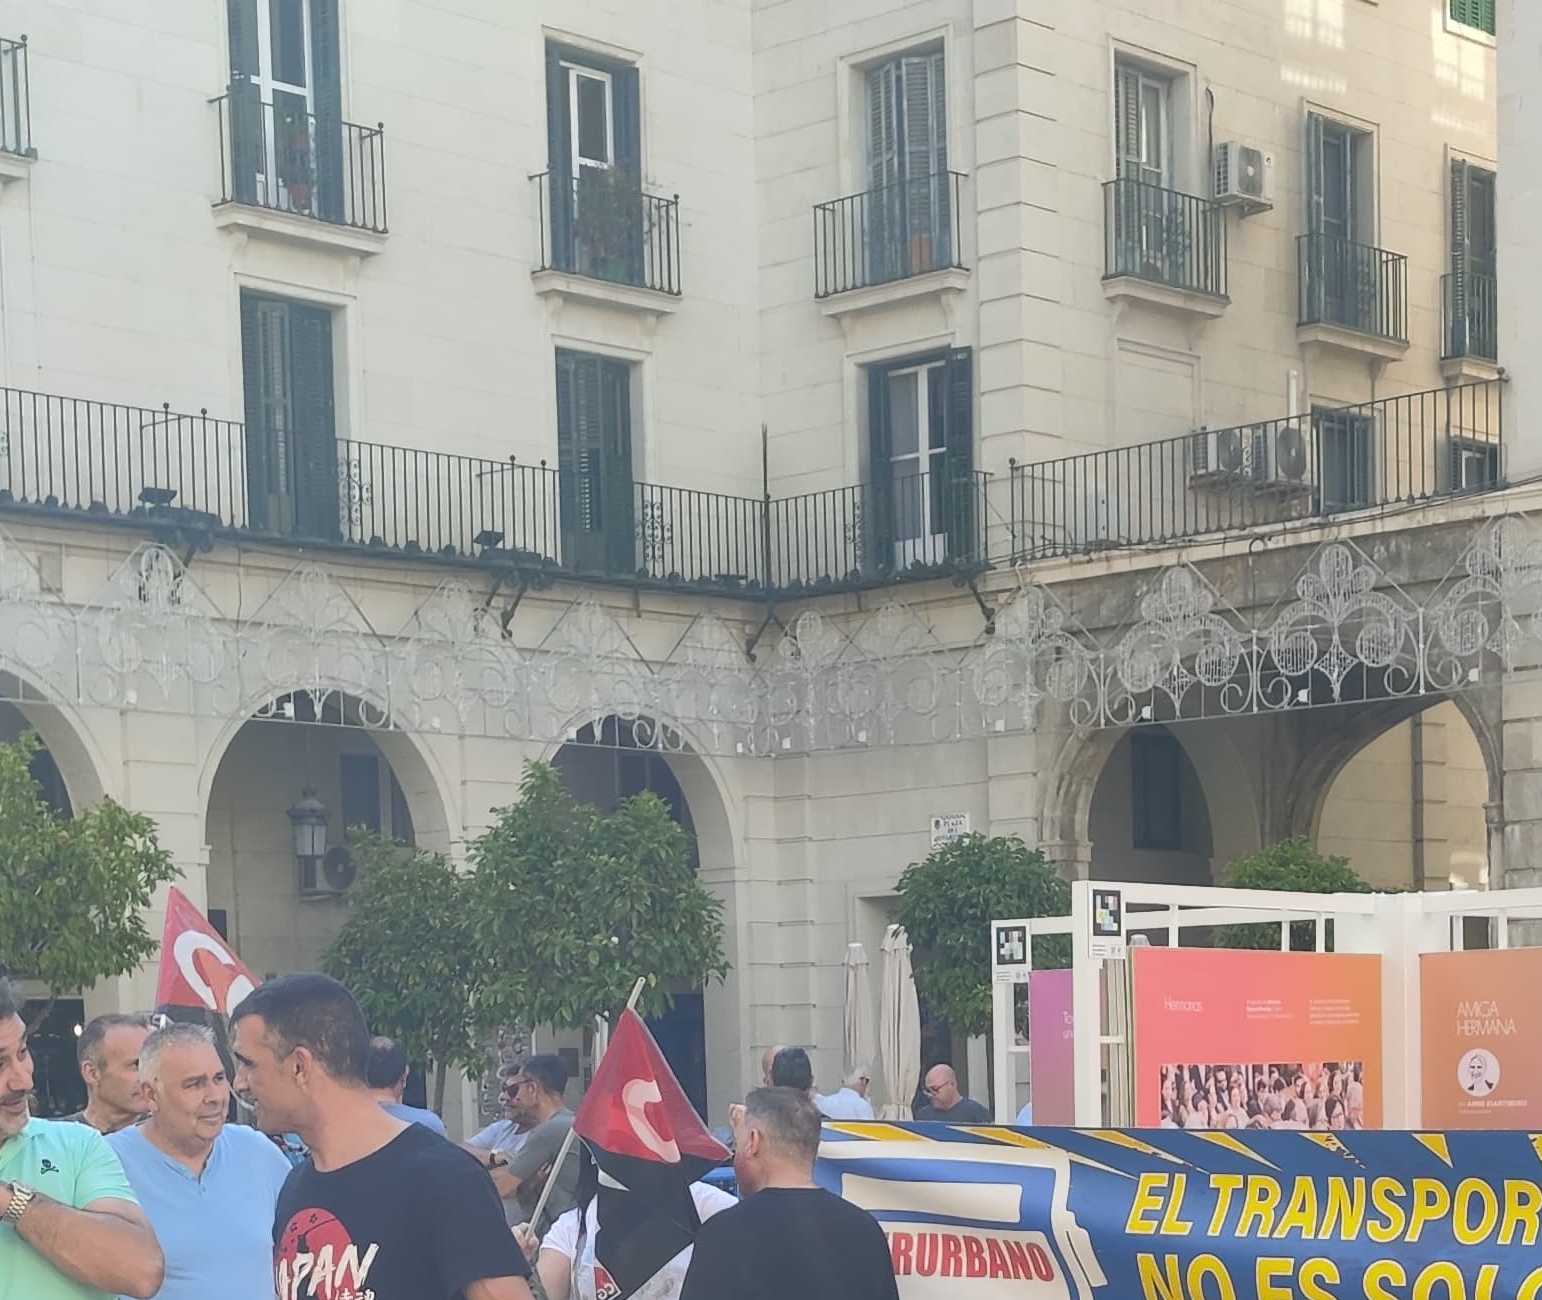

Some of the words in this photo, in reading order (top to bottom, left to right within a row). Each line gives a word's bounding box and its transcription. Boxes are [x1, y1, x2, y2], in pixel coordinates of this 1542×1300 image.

[1458, 1000, 1499, 1018] AMIGA
[1457, 1018, 1517, 1036] HERMANA
[1125, 1171, 1194, 1237] EL
[886, 1232, 1055, 1282] RURBANO
